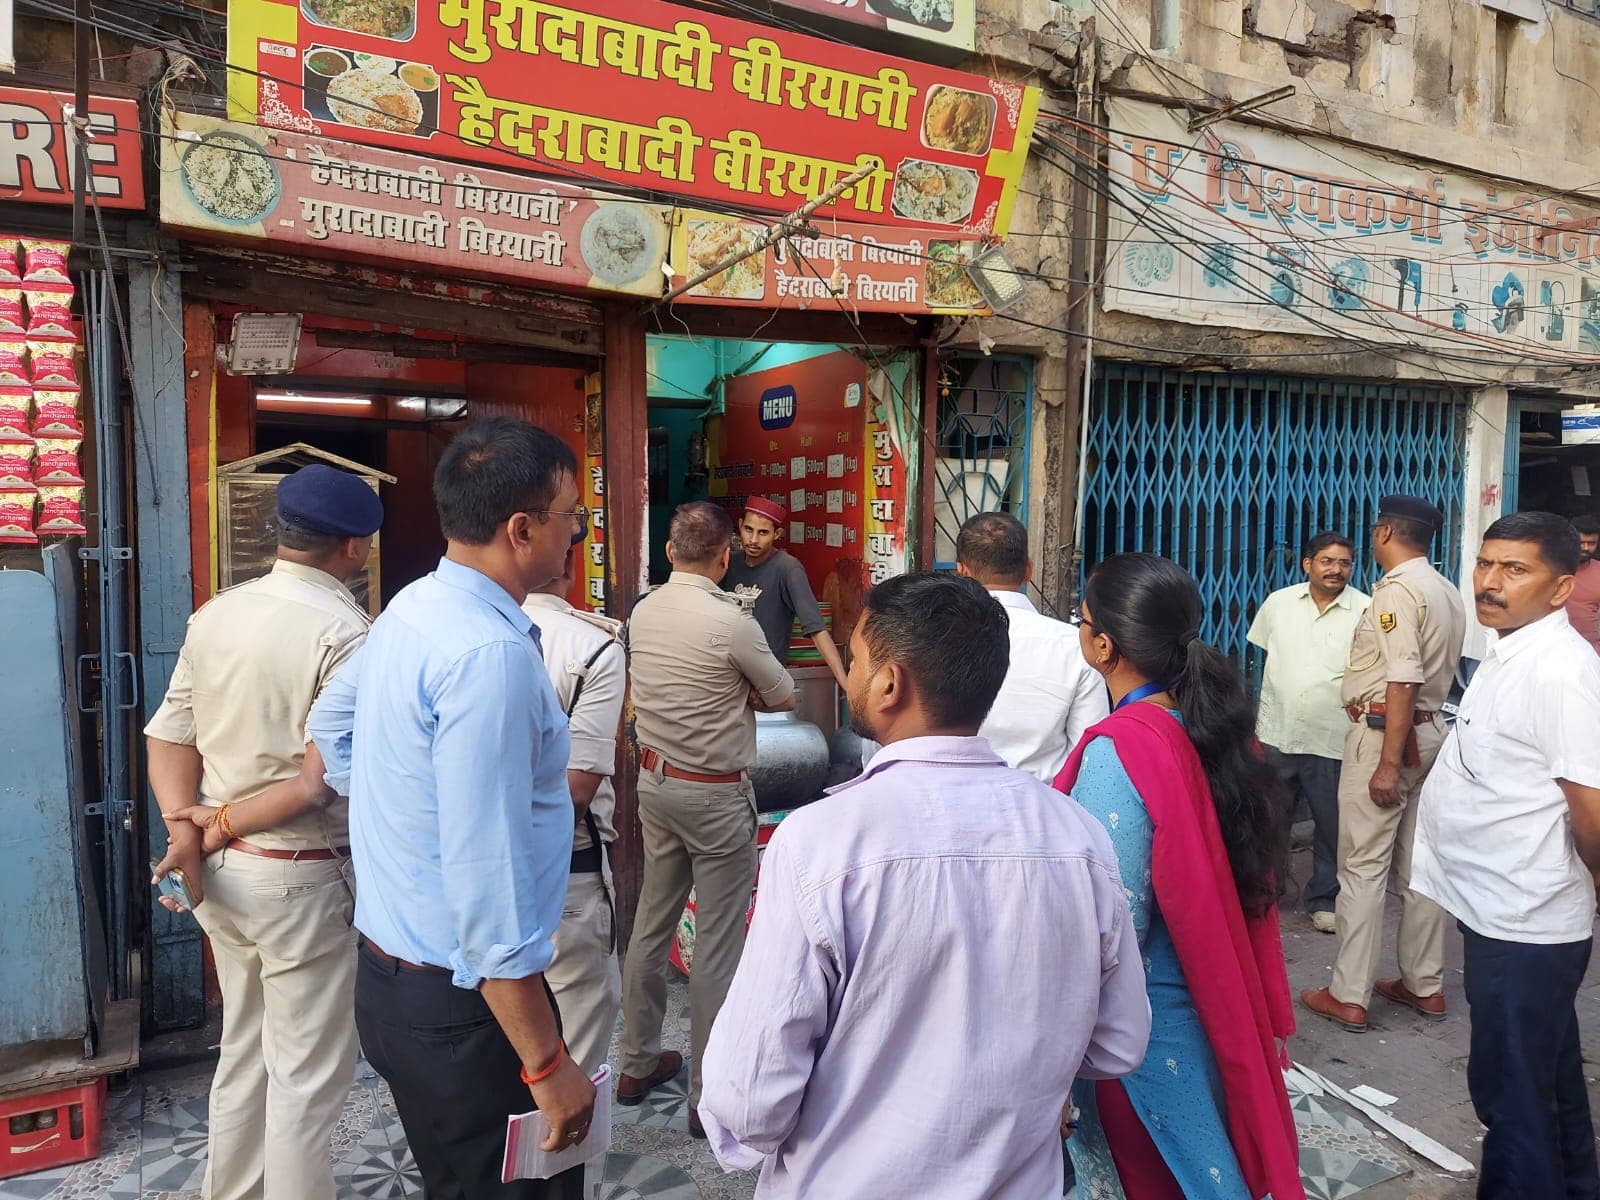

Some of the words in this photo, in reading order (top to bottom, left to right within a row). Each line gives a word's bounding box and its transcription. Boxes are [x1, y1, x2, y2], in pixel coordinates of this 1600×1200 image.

[727, 37, 918, 131] बीरयानी
[443, 72, 703, 183] हैदराबादी
[709, 128, 894, 214] बीरयानी
[304, 143, 446, 205] हैदराबादी
[452, 172, 566, 225] बिरयानी
[298, 196, 451, 249] मुरादाबादी
[457, 216, 567, 267] बिरयानी
[861, 235, 923, 266] बिरयानी
[856, 274, 918, 303] बिरयानी
[763, 396, 793, 421] MENU
